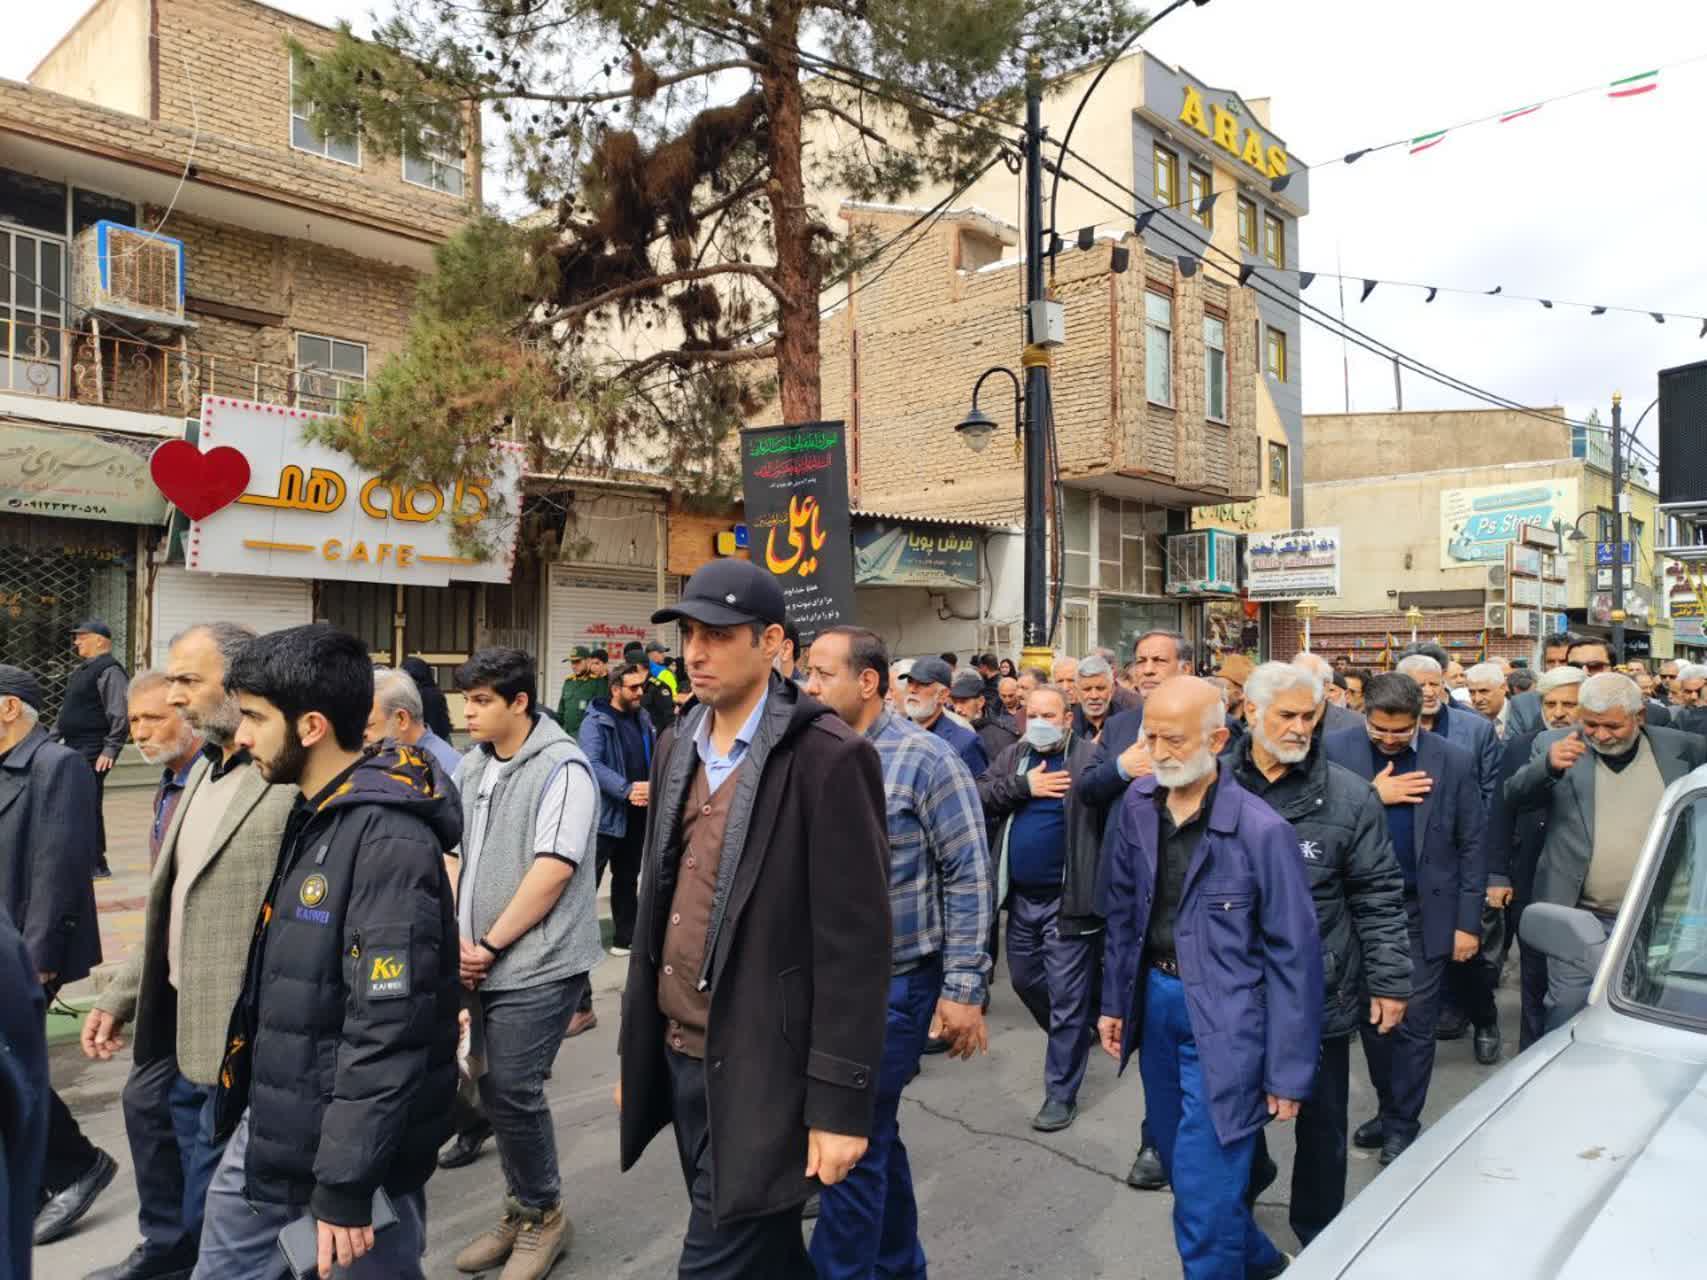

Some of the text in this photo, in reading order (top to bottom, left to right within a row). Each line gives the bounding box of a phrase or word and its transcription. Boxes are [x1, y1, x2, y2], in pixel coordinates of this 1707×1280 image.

[1179, 84, 1287, 179] ARAS
[321, 538, 416, 568] CAFE
[766, 495, 816, 575] علی
[908, 531, 973, 556] فرش پویا
